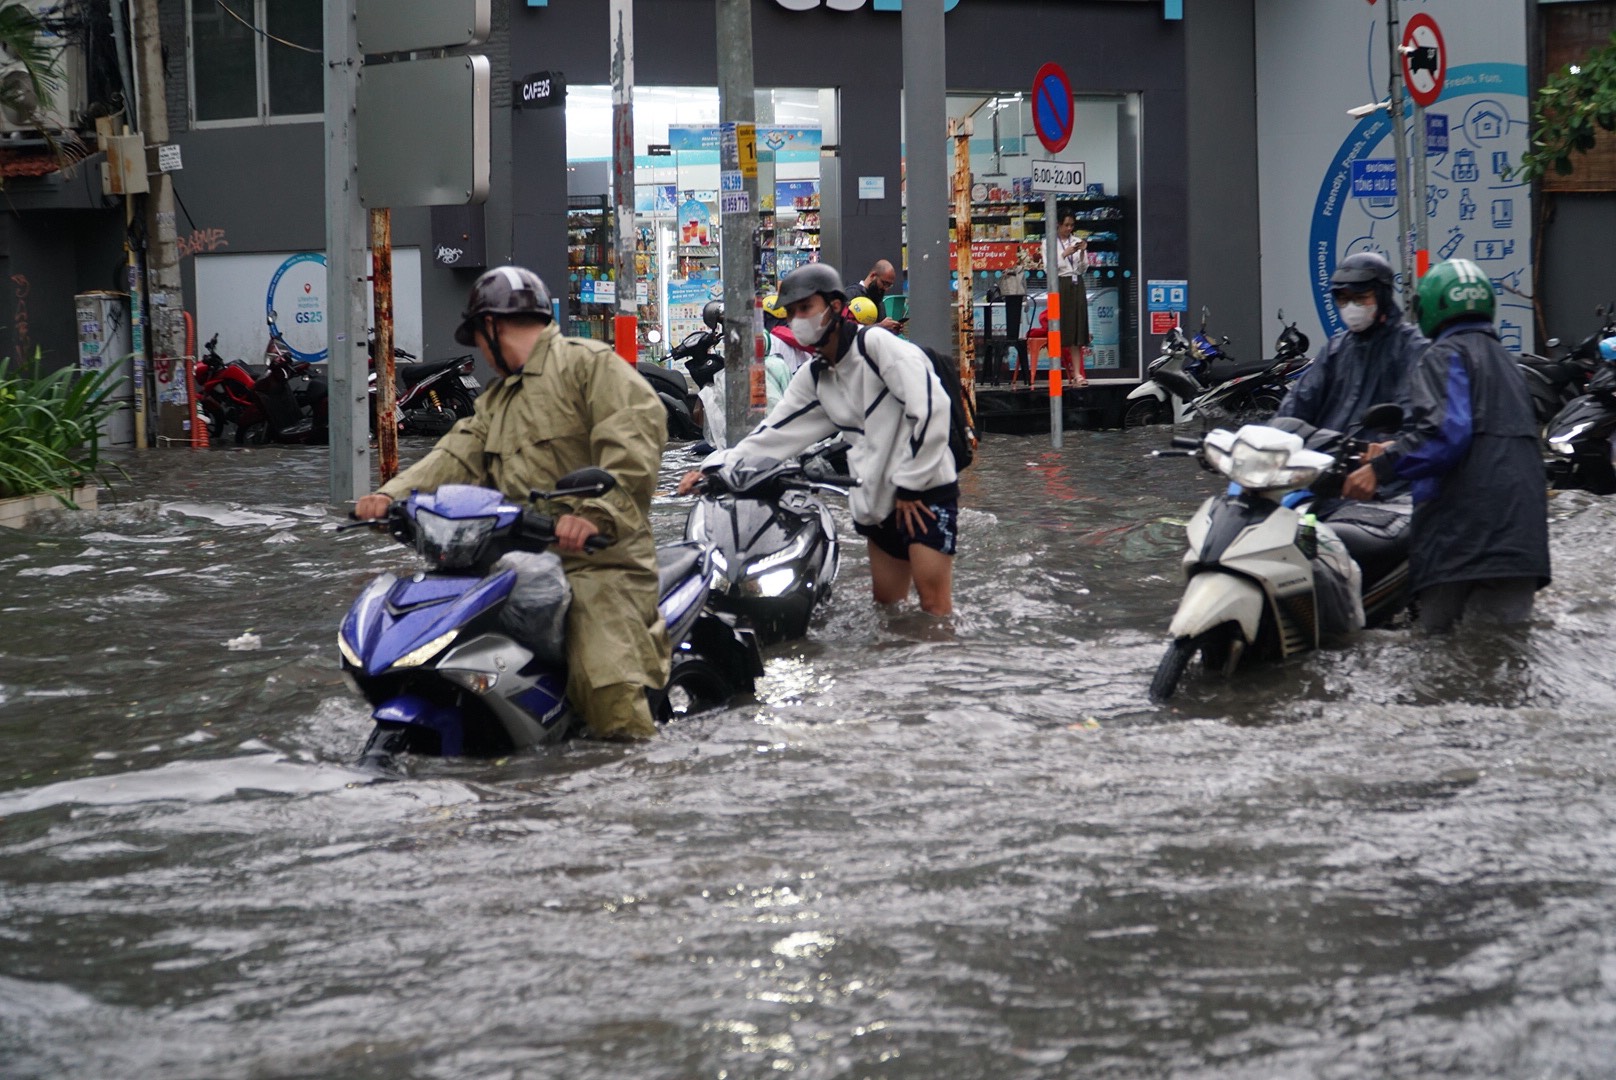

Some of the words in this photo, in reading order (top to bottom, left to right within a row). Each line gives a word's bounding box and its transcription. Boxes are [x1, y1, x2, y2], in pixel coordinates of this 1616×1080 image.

[523, 79, 550, 100] CAFE25
[1323, 170, 1347, 216] Friendly.
[1318, 241, 1329, 291] Friendly.
[1449, 284, 1489, 301] Grab
[296, 312, 323, 323] GS25
[1097, 307, 1114, 318] GS25
